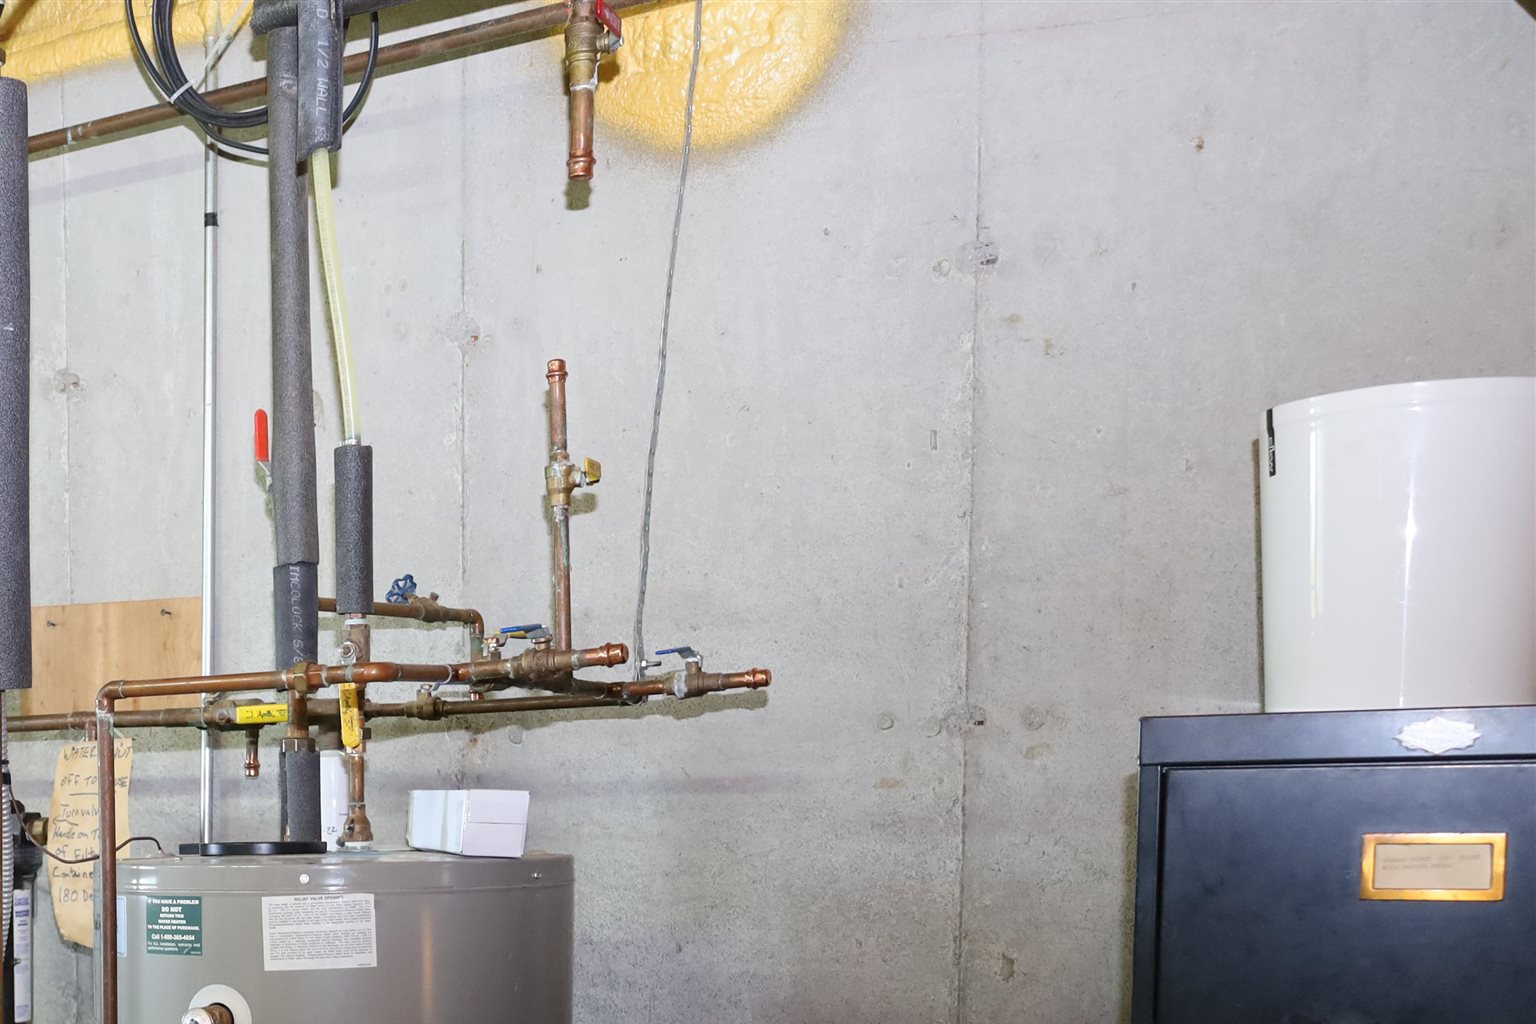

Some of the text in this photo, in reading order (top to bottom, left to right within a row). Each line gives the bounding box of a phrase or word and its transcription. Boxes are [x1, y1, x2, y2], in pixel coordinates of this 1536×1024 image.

[316, 39, 329, 69] 1/2
[314, 78, 329, 116] WALL
[52, 866, 94, 879] Containe
[58, 887, 79, 902] 180
